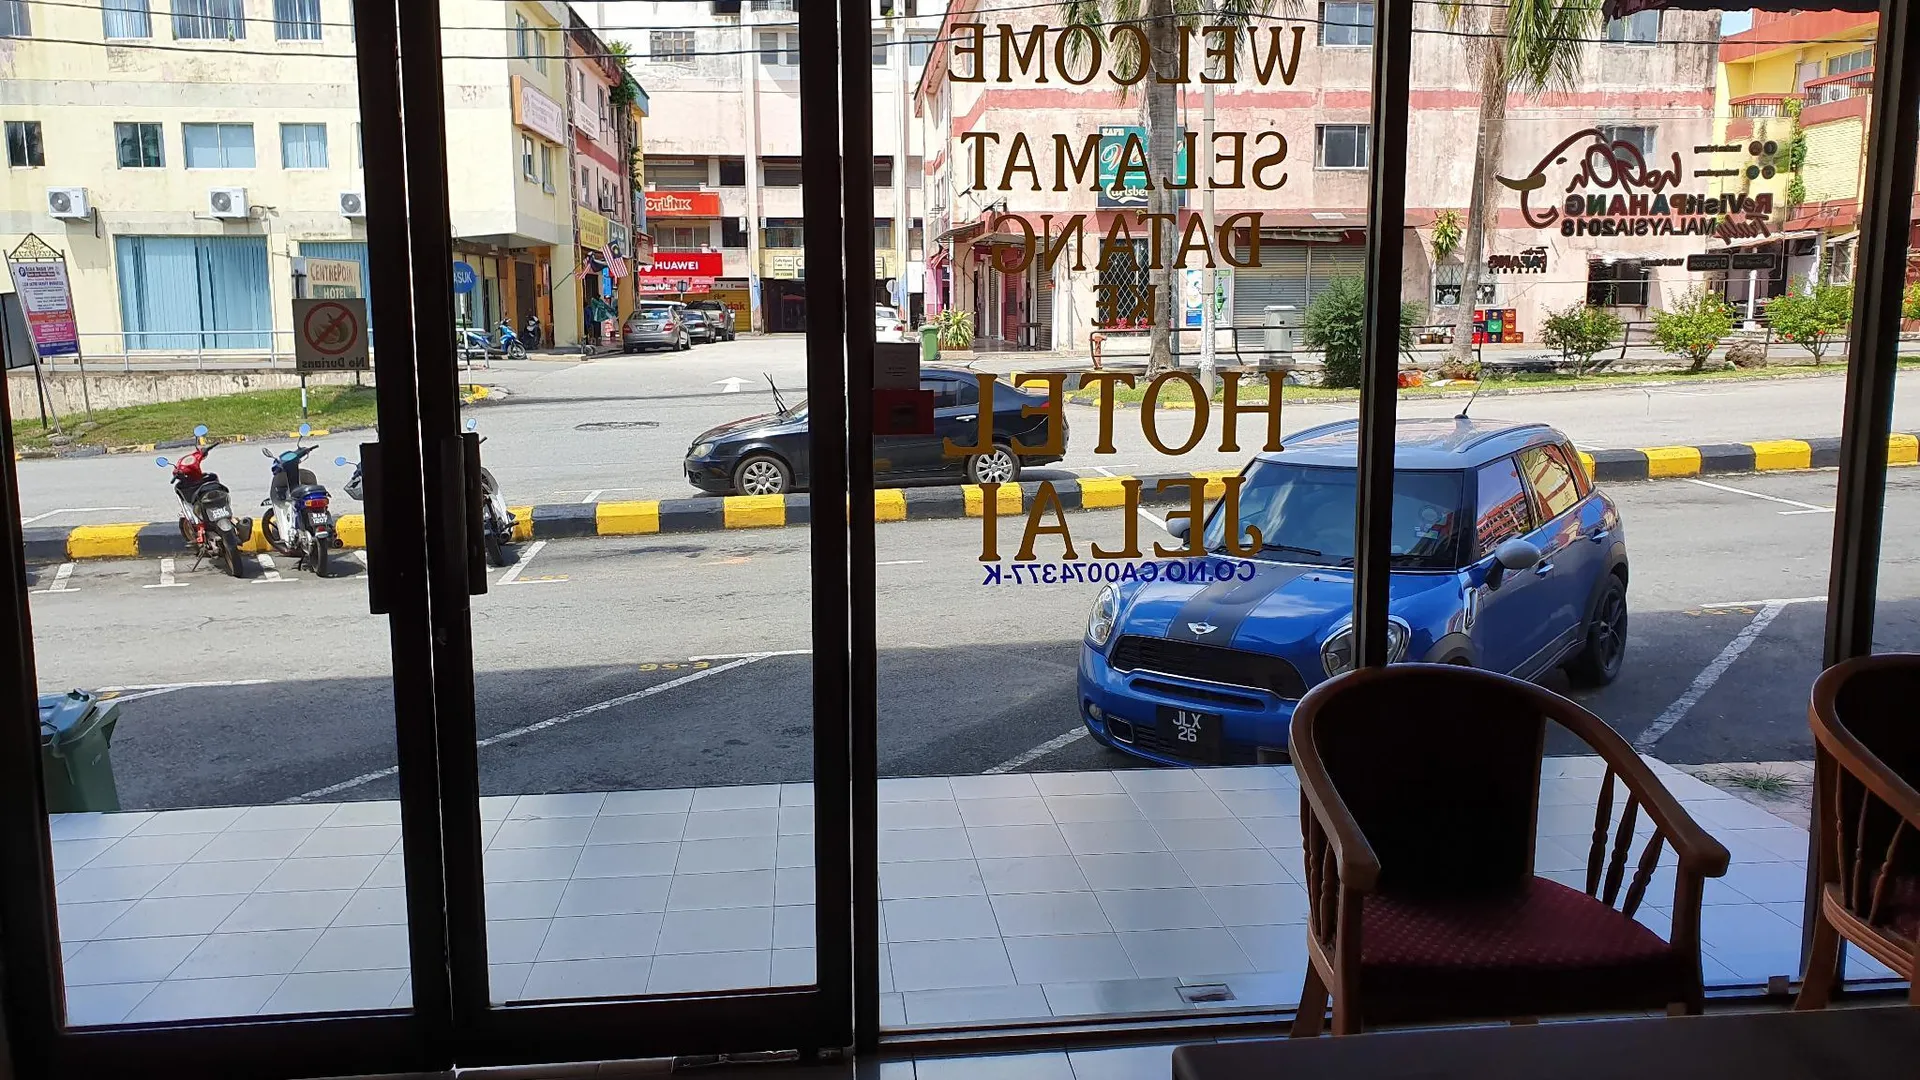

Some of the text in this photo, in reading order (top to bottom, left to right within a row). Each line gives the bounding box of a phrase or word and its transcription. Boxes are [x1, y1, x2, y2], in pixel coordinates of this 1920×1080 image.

[1106, 183, 1149, 200] Carlsber
[655, 262, 699, 271] HUAWEI
[323, 286, 347, 299] HOTEL
[1172, 710, 1201, 729] JLX
[1178, 726, 1198, 743] 26
